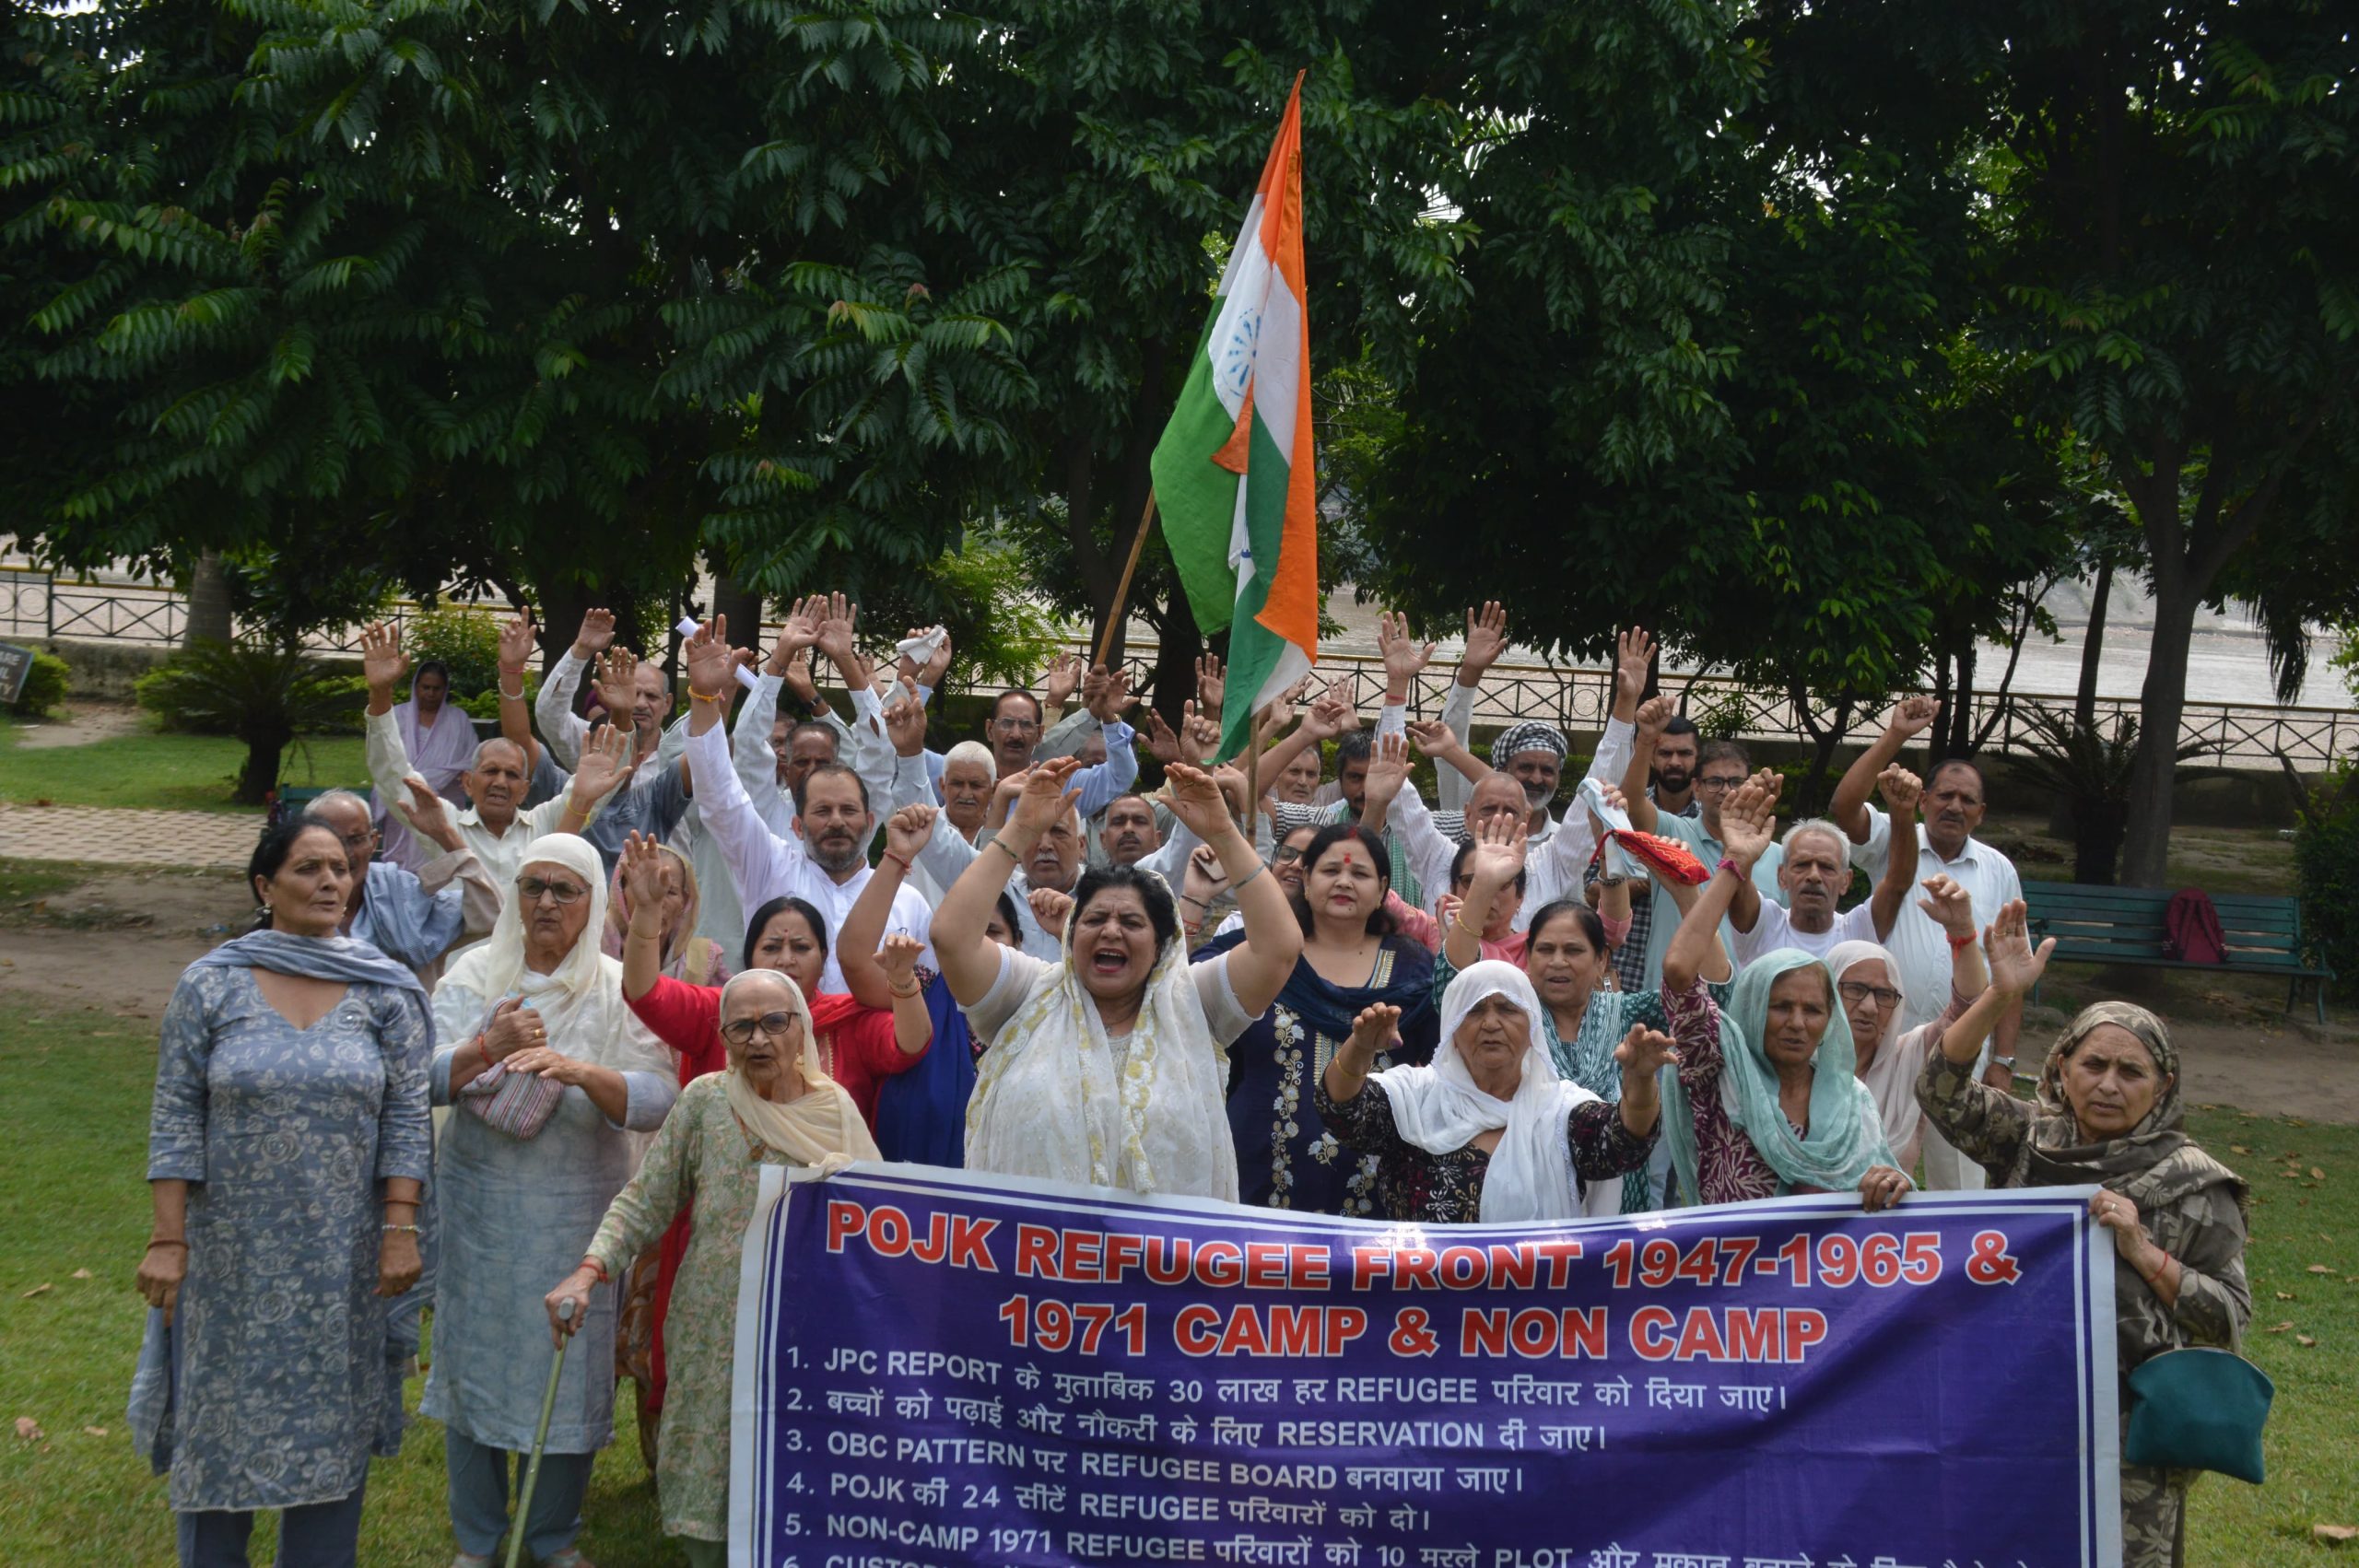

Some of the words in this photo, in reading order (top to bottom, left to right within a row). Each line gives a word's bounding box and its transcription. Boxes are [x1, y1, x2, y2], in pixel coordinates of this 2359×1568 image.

[826, 1199, 1001, 1273] POJK
[1015, 1223, 1332, 1289] REFUGEE
[1351, 1245, 1582, 1291] FRONT
[1603, 1231, 1942, 1288] 1947-1965
[1965, 1229, 2023, 1286] &
[998, 1293, 1147, 1357] 1971
[1172, 1302, 1368, 1358] CAMP
[1387, 1305, 1441, 1359] &
[1459, 1305, 1609, 1361] NON
[1627, 1304, 1829, 1364] CAMP
[786, 1345, 809, 1369] 1.
[823, 1347, 878, 1375] JPC
[886, 1350, 1003, 1386] REPORT
[1014, 1361, 1042, 1391] के
[1051, 1371, 1156, 1405] मुताबिक
[1168, 1378, 1203, 1403] 30
[1215, 1378, 1283, 1403] लाख
[1292, 1378, 1330, 1406] हर
[1336, 1376, 1478, 1404] REFUGEE
[1490, 1373, 1583, 1406] परिवार
[1592, 1374, 1634, 1408] को
[1644, 1376, 1708, 1410] दिया
[786, 1387, 814, 1411] 2.
[826, 1386, 885, 1418] बच्चों
[894, 1387, 934, 1421] को
[944, 1395, 1004, 1430] पढ़ाई
[1016, 1399, 1066, 1435] और
[1075, 1408, 1159, 1443] नौकरी
[1168, 1413, 1199, 1445] के
[1209, 1415, 1264, 1449] लिए
[1277, 1421, 1485, 1448] RESERVATION
[1497, 1417, 1528, 1452] दी
[785, 1428, 812, 1453] 3.
[827, 1430, 888, 1459] OBC
[897, 1437, 1026, 1469] PATTERN
[1031, 1448, 1068, 1474] पर
[1081, 1451, 1221, 1483] REFUGEE
[1230, 1462, 1337, 1490] BOARD
[1344, 1466, 1446, 1492] बनवाया
[785, 1471, 815, 1495] 4.
[830, 1472, 905, 1504] POJK
[910, 1476, 950, 1508] की
[962, 1483, 1002, 1509] 24
[1013, 1481, 1067, 1513] सीटें
[1080, 1492, 1220, 1521] REFUGEE
[1226, 1495, 1328, 1526] परिवारों
[1338, 1501, 1378, 1529] को
[784, 1512, 812, 1537] 5.
[827, 1514, 980, 1552] NON-CAMP
[989, 1527, 1050, 1554] 1971
[1066, 1531, 1206, 1561] REFUGEE
[1213, 1533, 1313, 1566] परिवारों
[1323, 1536, 1363, 1567] को
[1376, 1544, 1405, 1568] 10
[1495, 1547, 1574, 1568] PLOT
